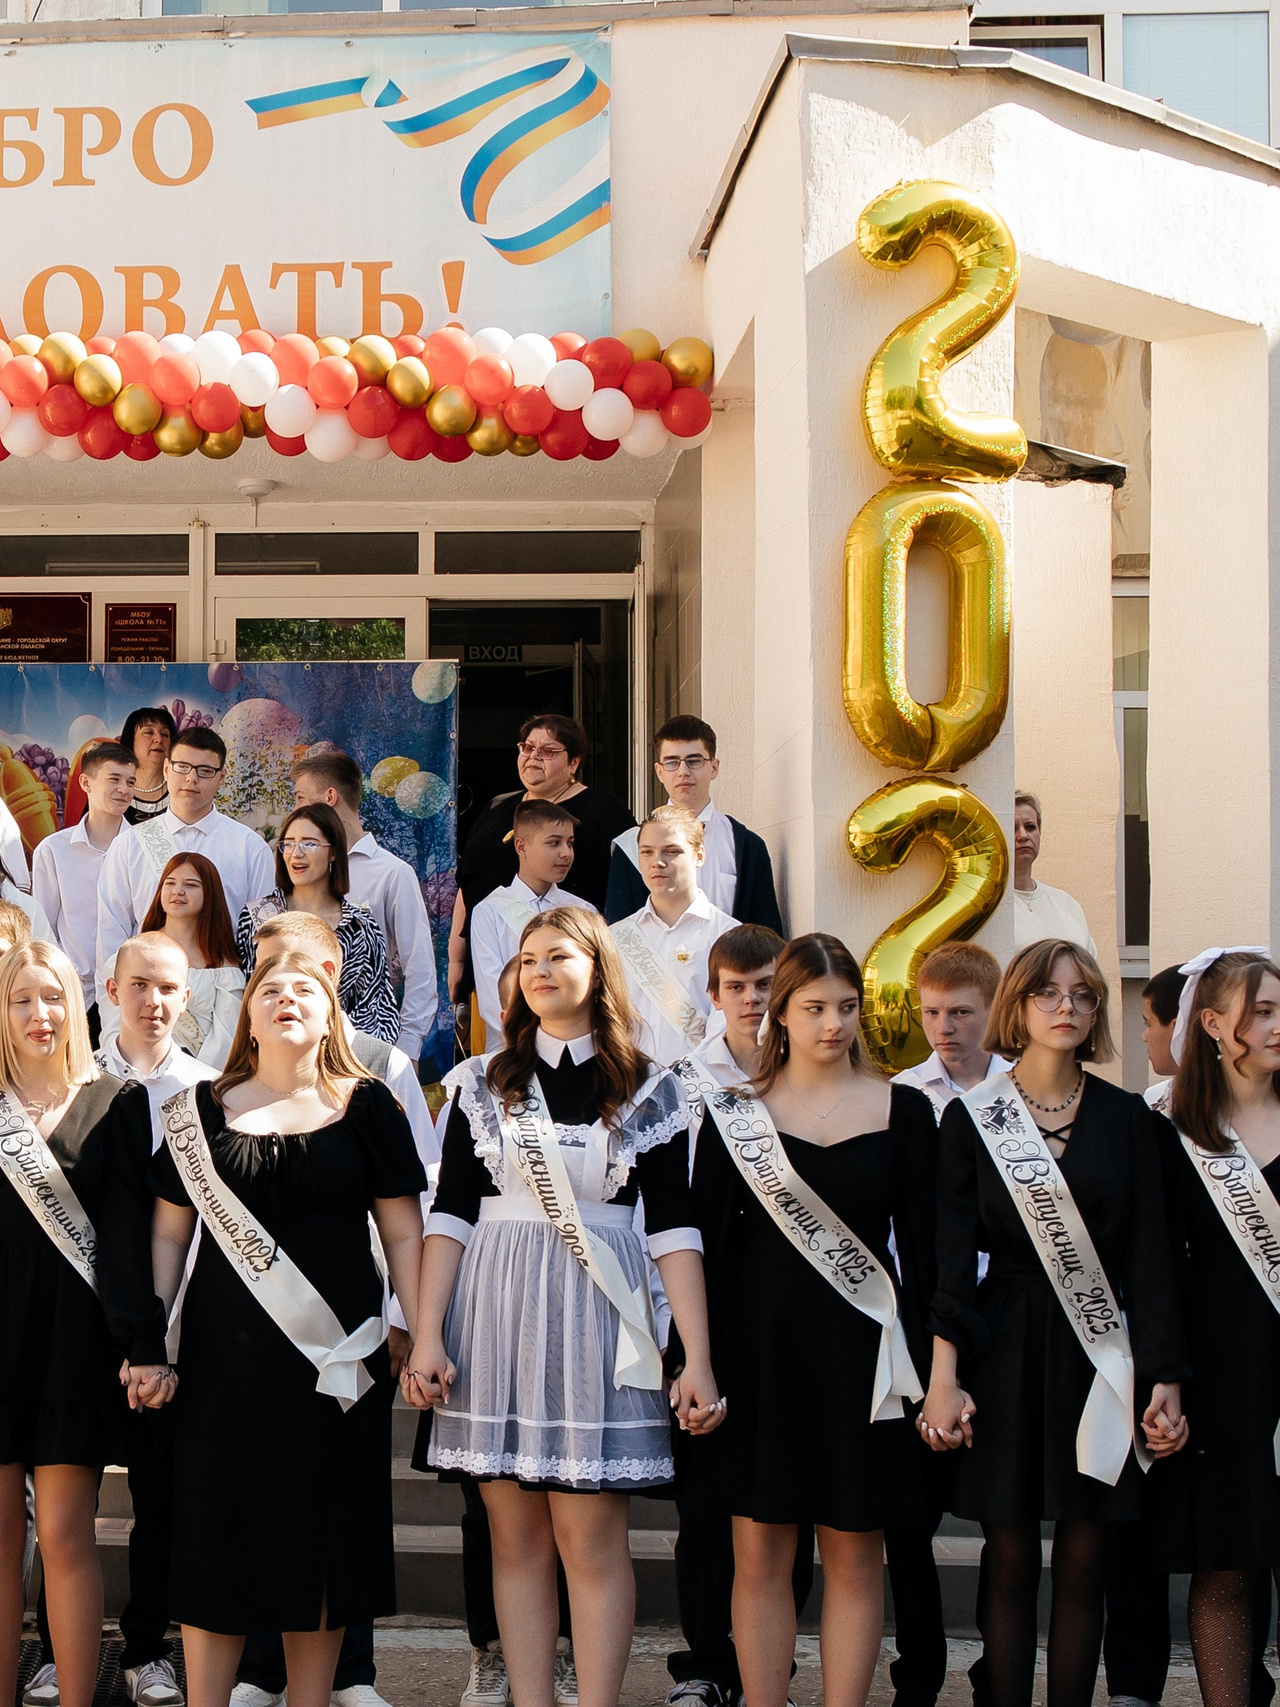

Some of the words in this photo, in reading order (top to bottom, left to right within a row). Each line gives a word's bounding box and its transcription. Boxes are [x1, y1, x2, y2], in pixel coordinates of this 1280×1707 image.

[468, 645, 519, 662] ВХОД
[166, 1110, 239, 1239] Выпускница
[725, 1118, 826, 1252] Выпускник
[823, 1238, 878, 1285] 2025
[995, 1139, 1084, 1289] Выпускник
[1074, 1286, 1120, 1335] 2025
